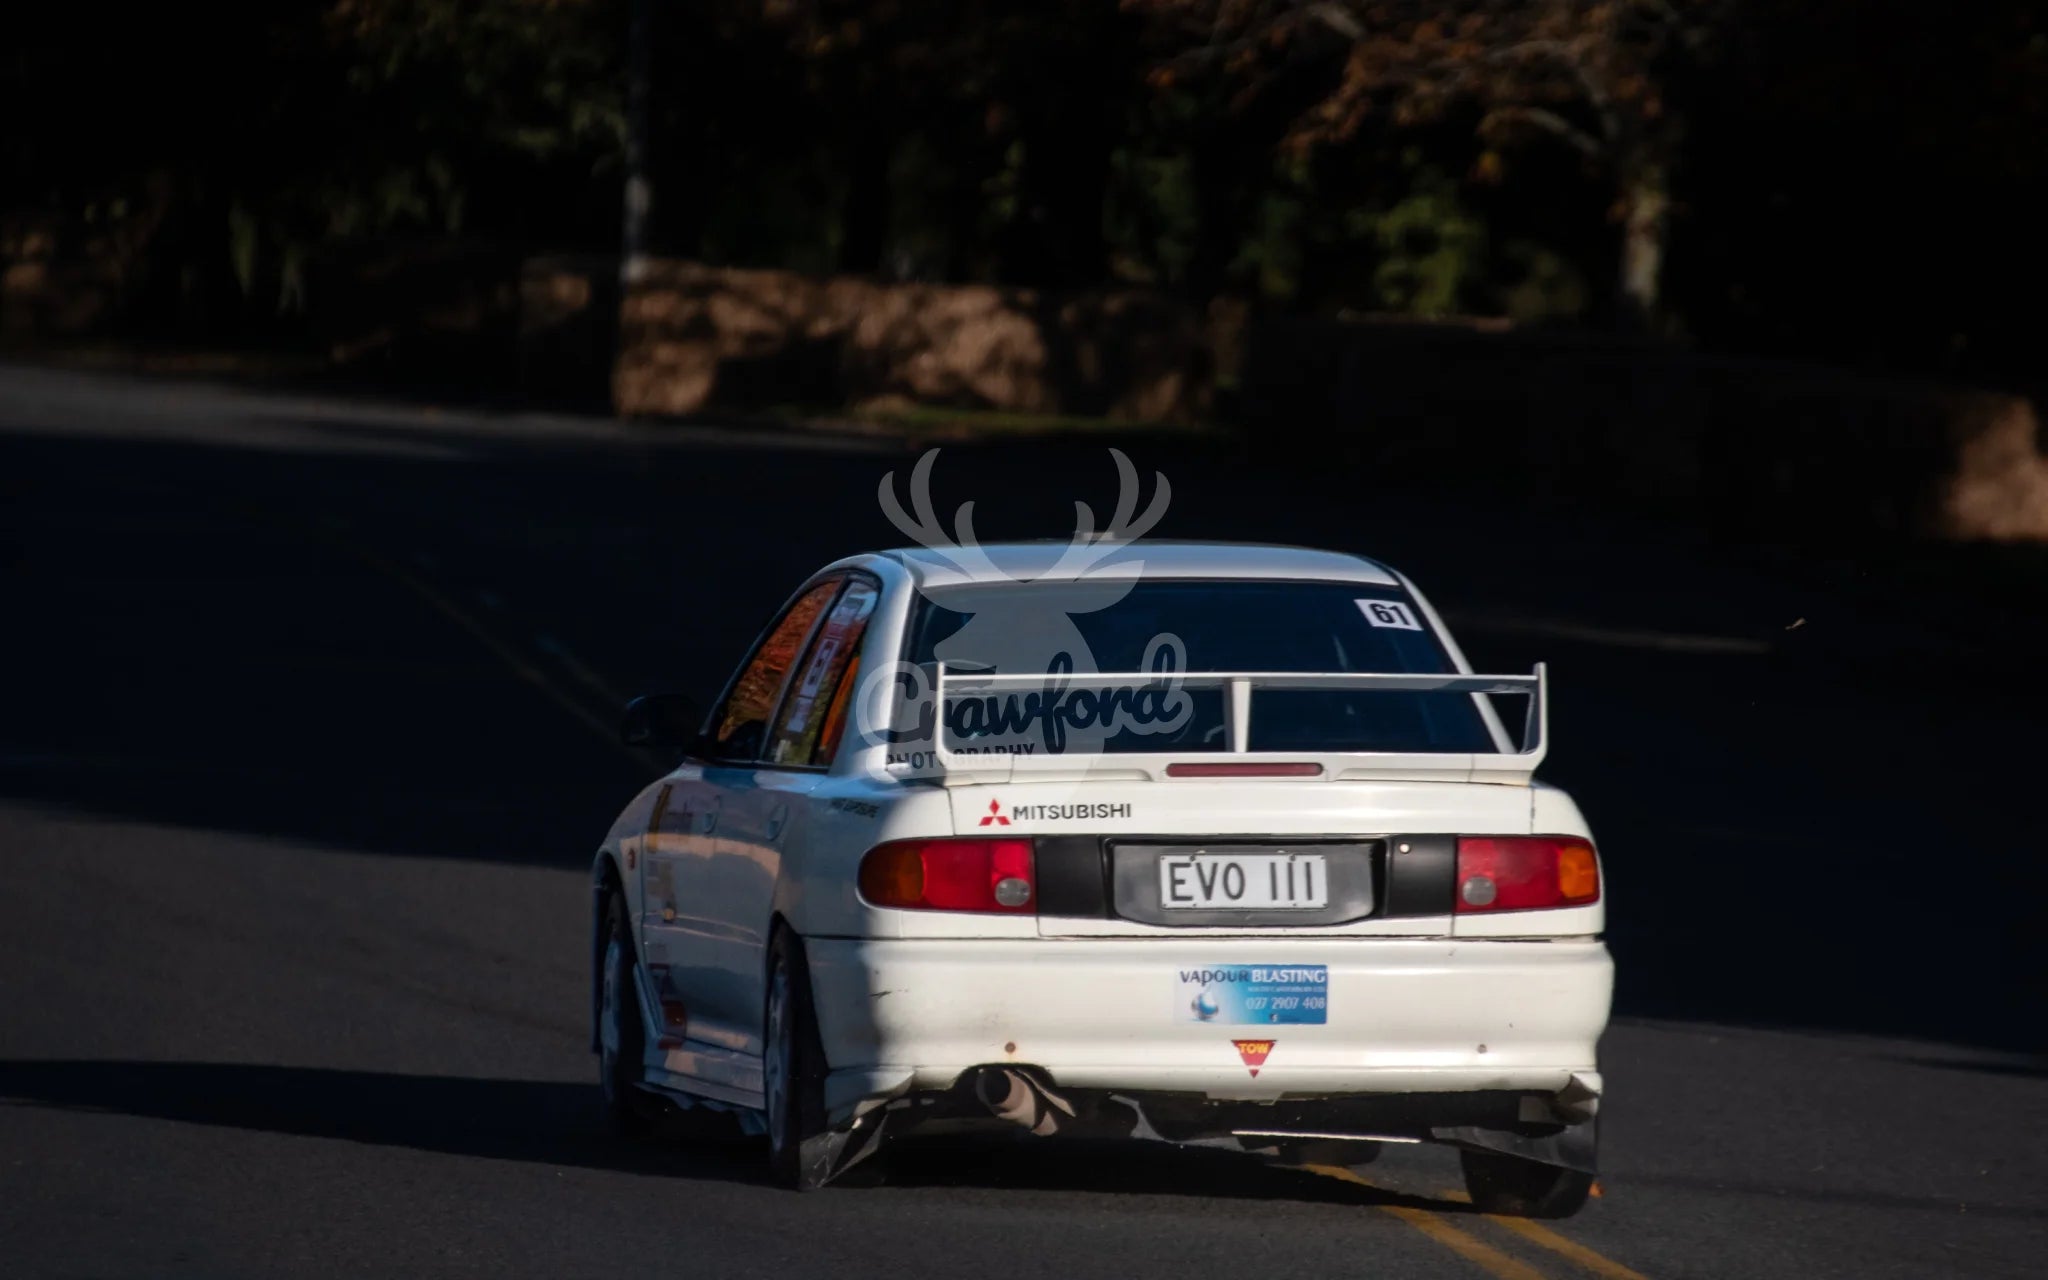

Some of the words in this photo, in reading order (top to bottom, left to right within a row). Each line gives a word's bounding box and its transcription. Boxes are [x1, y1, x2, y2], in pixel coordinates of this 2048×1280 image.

[1368, 603, 1411, 626] 61
[1013, 804, 1132, 820] MITSUBISHI
[1169, 862, 1246, 901] EVO
[1180, 970, 1249, 986] VAPOUR
[1252, 969, 1325, 983] BLASTING
[1238, 1043, 1269, 1054] TOW
